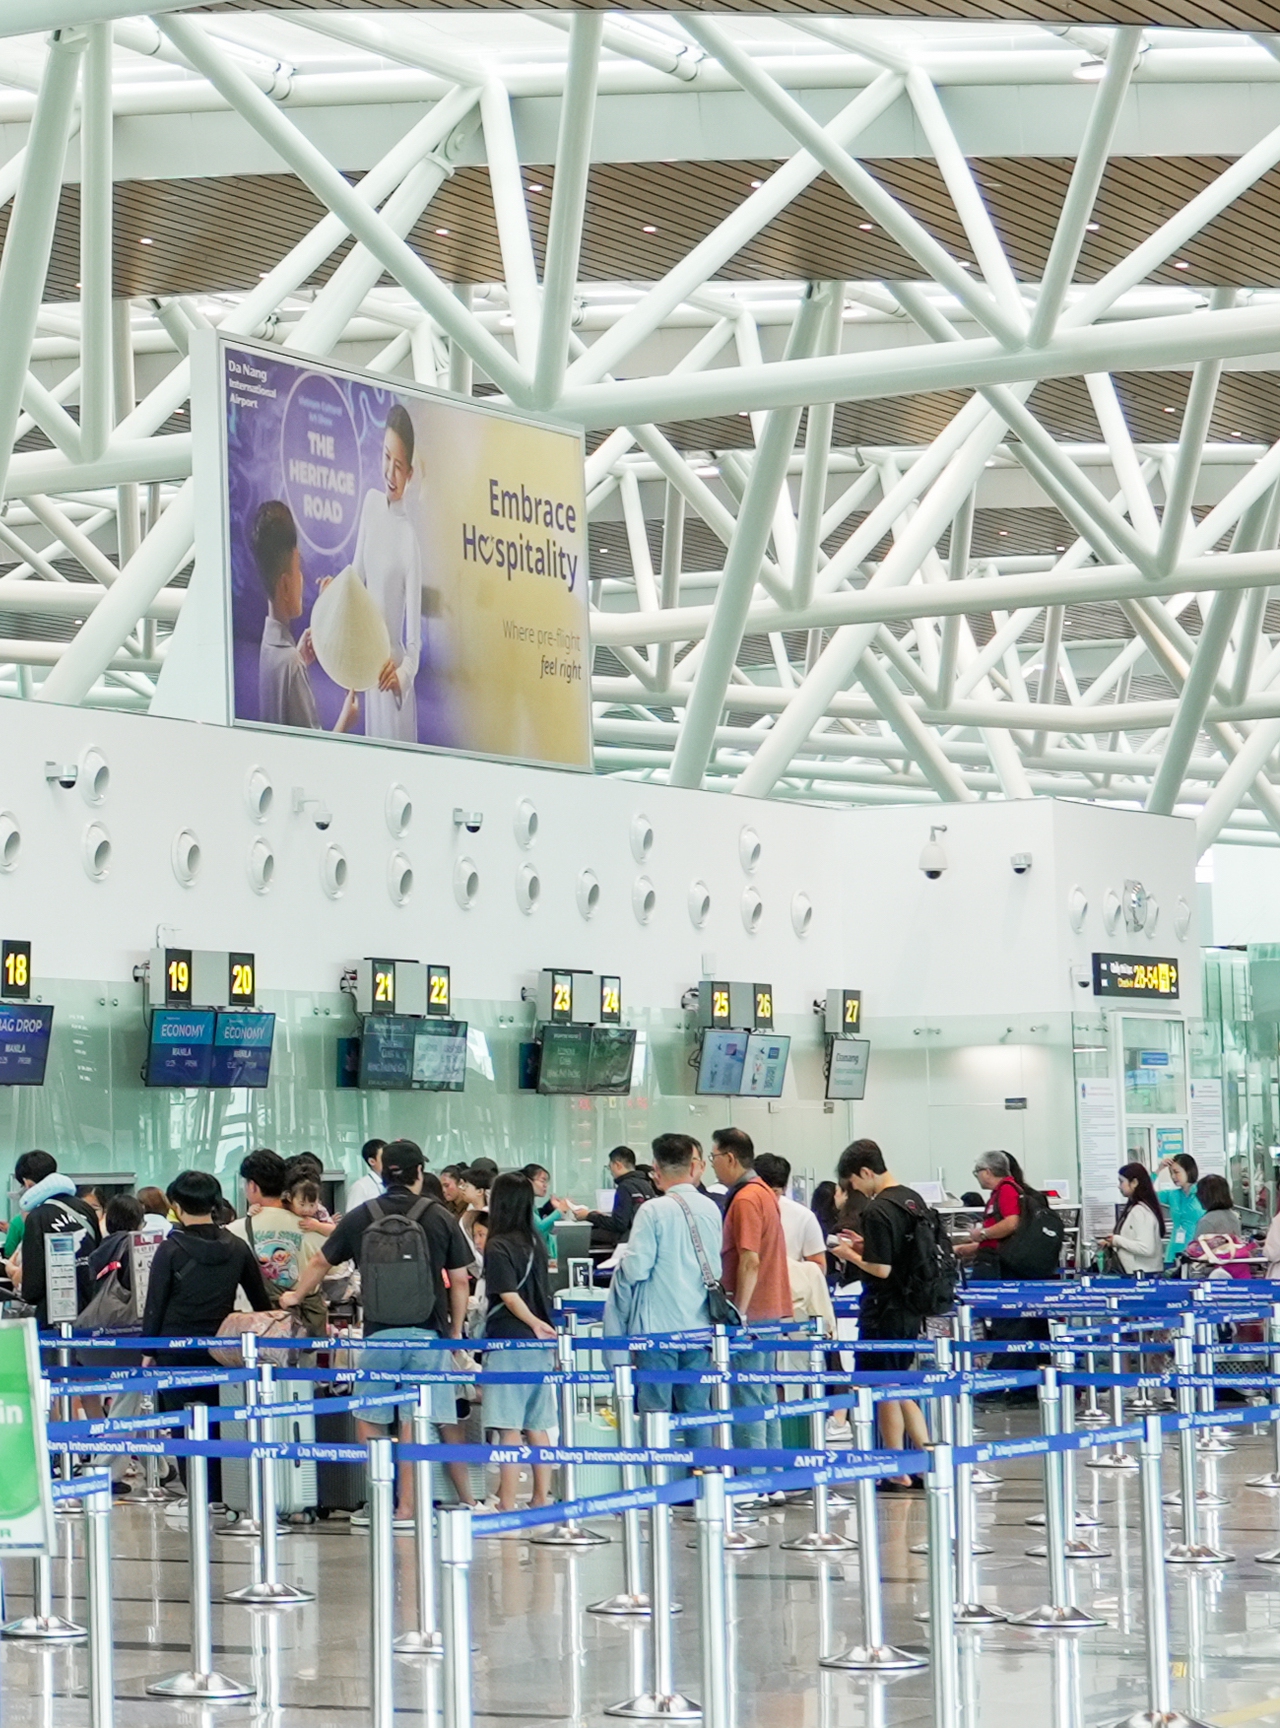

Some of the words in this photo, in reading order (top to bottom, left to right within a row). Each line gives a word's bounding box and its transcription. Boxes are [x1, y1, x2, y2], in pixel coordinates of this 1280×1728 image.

[228, 359, 242, 374] Da
[242, 363, 268, 383] Nang
[228, 379, 277, 398] International
[229, 392, 259, 409] Airport
[307, 430, 335, 461] THE
[288, 458, 356, 497] HERITAGE
[303, 493, 344, 525] ROAD
[489, 478, 577, 533] Embrace
[503, 618, 535, 643] Where
[537, 627, 581, 655] pre-flight
[540, 655, 557, 679] feel
[559, 660, 582, 684] right
[5, 953, 28, 986] 18
[168, 960, 189, 993] 19
[231, 964, 253, 995] 20
[375, 972, 393, 1001] 21
[429, 975, 448, 1005] 22
[553, 983, 571, 1011] 23
[602, 986, 619, 1013] 24
[712, 991, 729, 1017] 25
[756, 993, 771, 1018] 26
[844, 999, 859, 1023] 27
[15, 1018, 43, 1033] DROP
[161, 1024, 205, 1038] ECONOMY
[224, 1027, 266, 1039] ECONOMY
[4, 1044, 26, 1053] MANILA
[700, 1374, 723, 1384] AHT
[738, 1374, 748, 1383] Da
[749, 1374, 770, 1384] Nang
[771, 1374, 819, 1383] International
[820, 1374, 852, 1383] Terminal
[1178, 1377, 1189, 1386] Da
[1190, 1377, 1214, 1388] Nang
[1214, 1377, 1267, 1387] International
[489, 1450, 520, 1463] AHT
[540, 1449, 554, 1461] Da
[555, 1450, 583, 1464] Nang
[584, 1451, 649, 1464] International
[650, 1452, 694, 1464] Terminal
